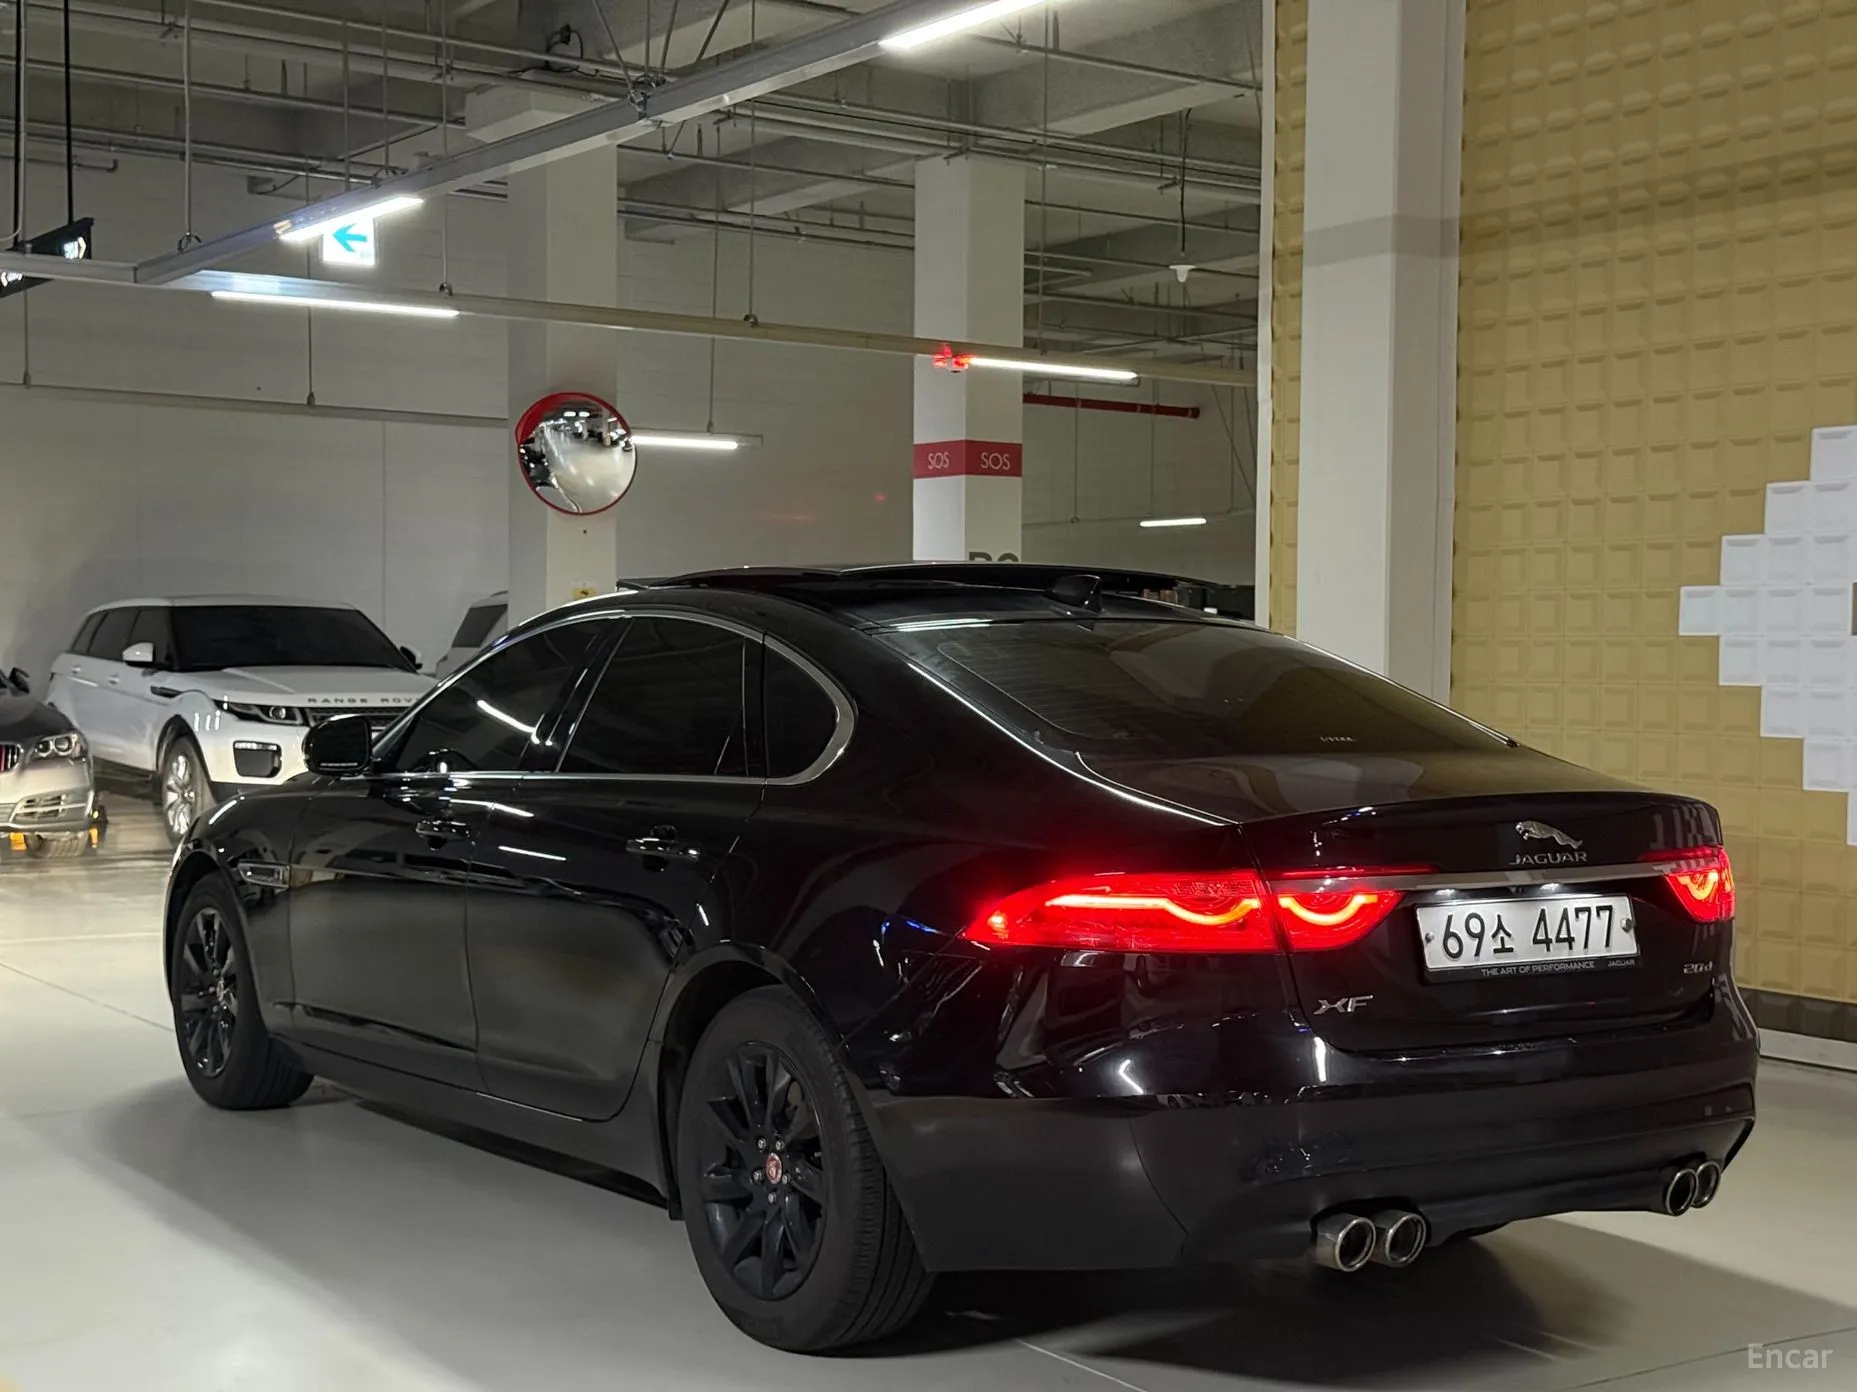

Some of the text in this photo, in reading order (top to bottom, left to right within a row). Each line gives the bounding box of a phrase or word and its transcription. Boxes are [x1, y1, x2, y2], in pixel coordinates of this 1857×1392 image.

[927, 451, 950, 470] SOS
[980, 452, 1010, 471] SOS
[1508, 851, 1588, 866] JAGUAR
[1442, 904, 1613, 959] 69소 4477
[1481, 959, 1635, 977] THE ART OF PERFORMANCE JAGUAR
[1313, 994, 1374, 1015] XF
